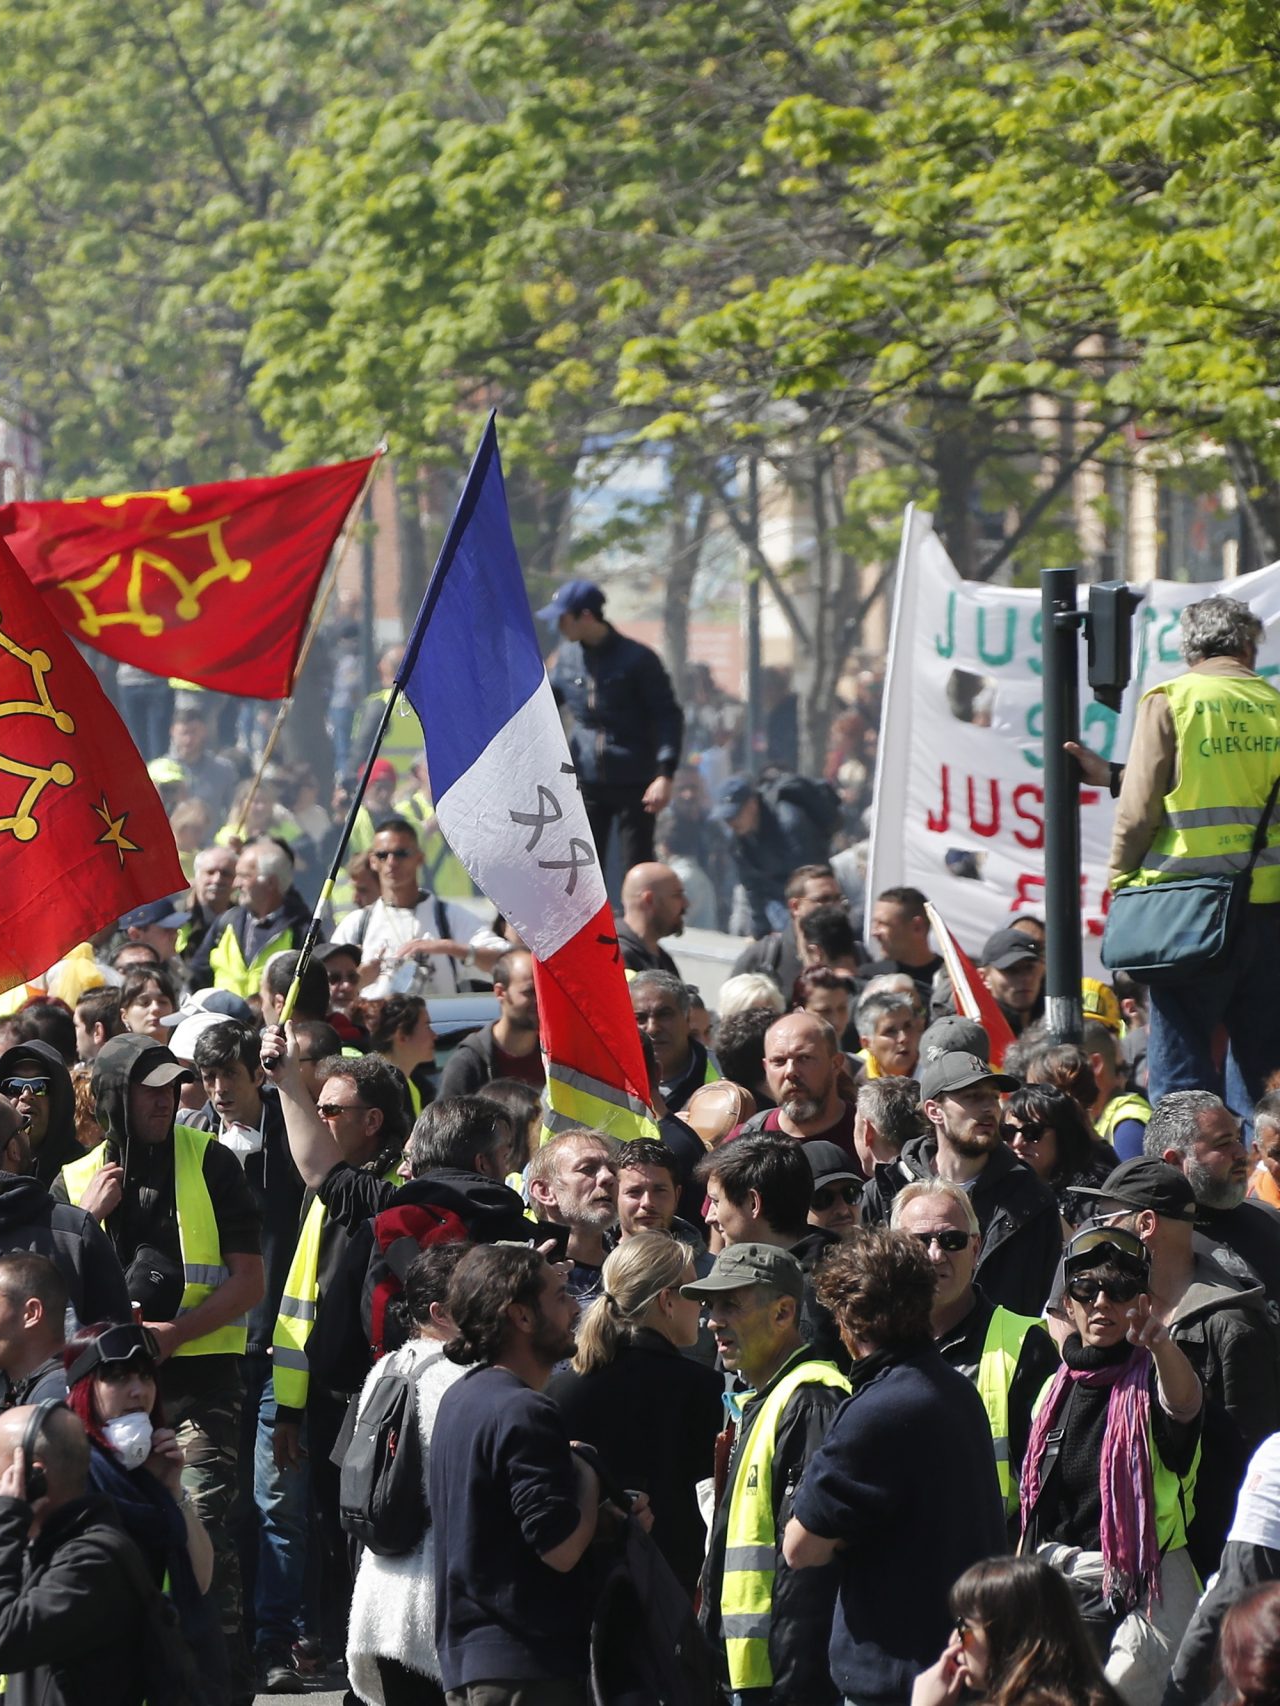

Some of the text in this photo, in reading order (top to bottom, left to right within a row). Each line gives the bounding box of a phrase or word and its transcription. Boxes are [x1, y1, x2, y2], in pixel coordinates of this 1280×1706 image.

[1194, 697, 1277, 718] ON VIENT
[1228, 720, 1248, 733] TE
